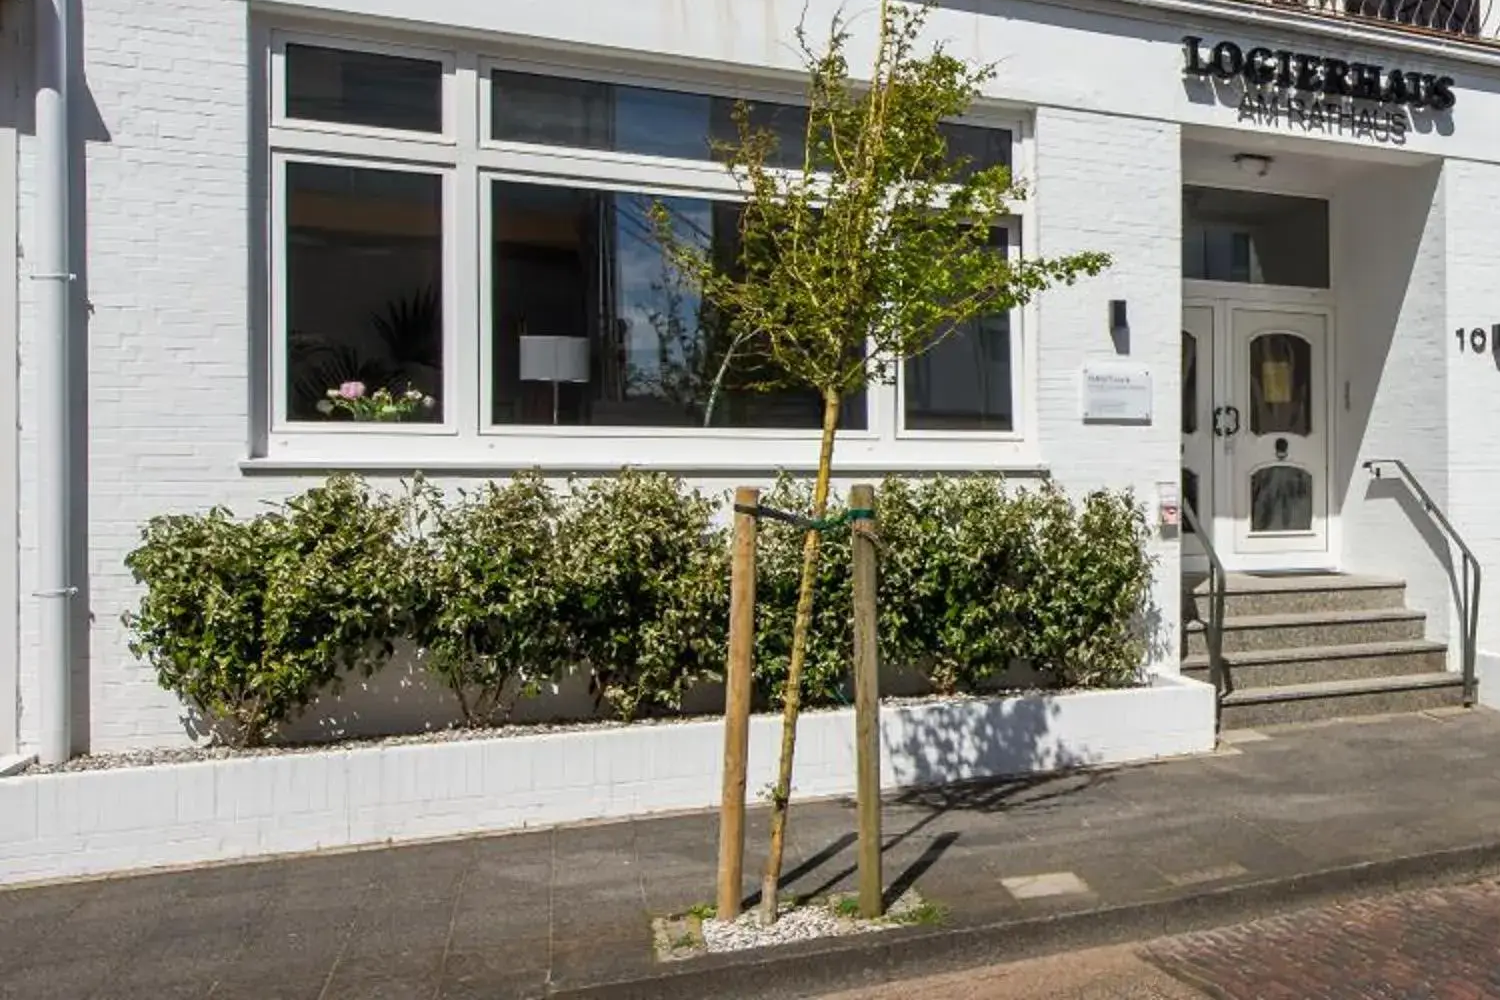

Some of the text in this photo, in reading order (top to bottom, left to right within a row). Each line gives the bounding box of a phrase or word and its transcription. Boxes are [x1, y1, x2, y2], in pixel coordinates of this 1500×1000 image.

[1182, 36, 1456, 110] LOGIERHAUS
[1237, 93, 1406, 144] AM RATHAUS
[1455, 327, 1487, 355] 10
